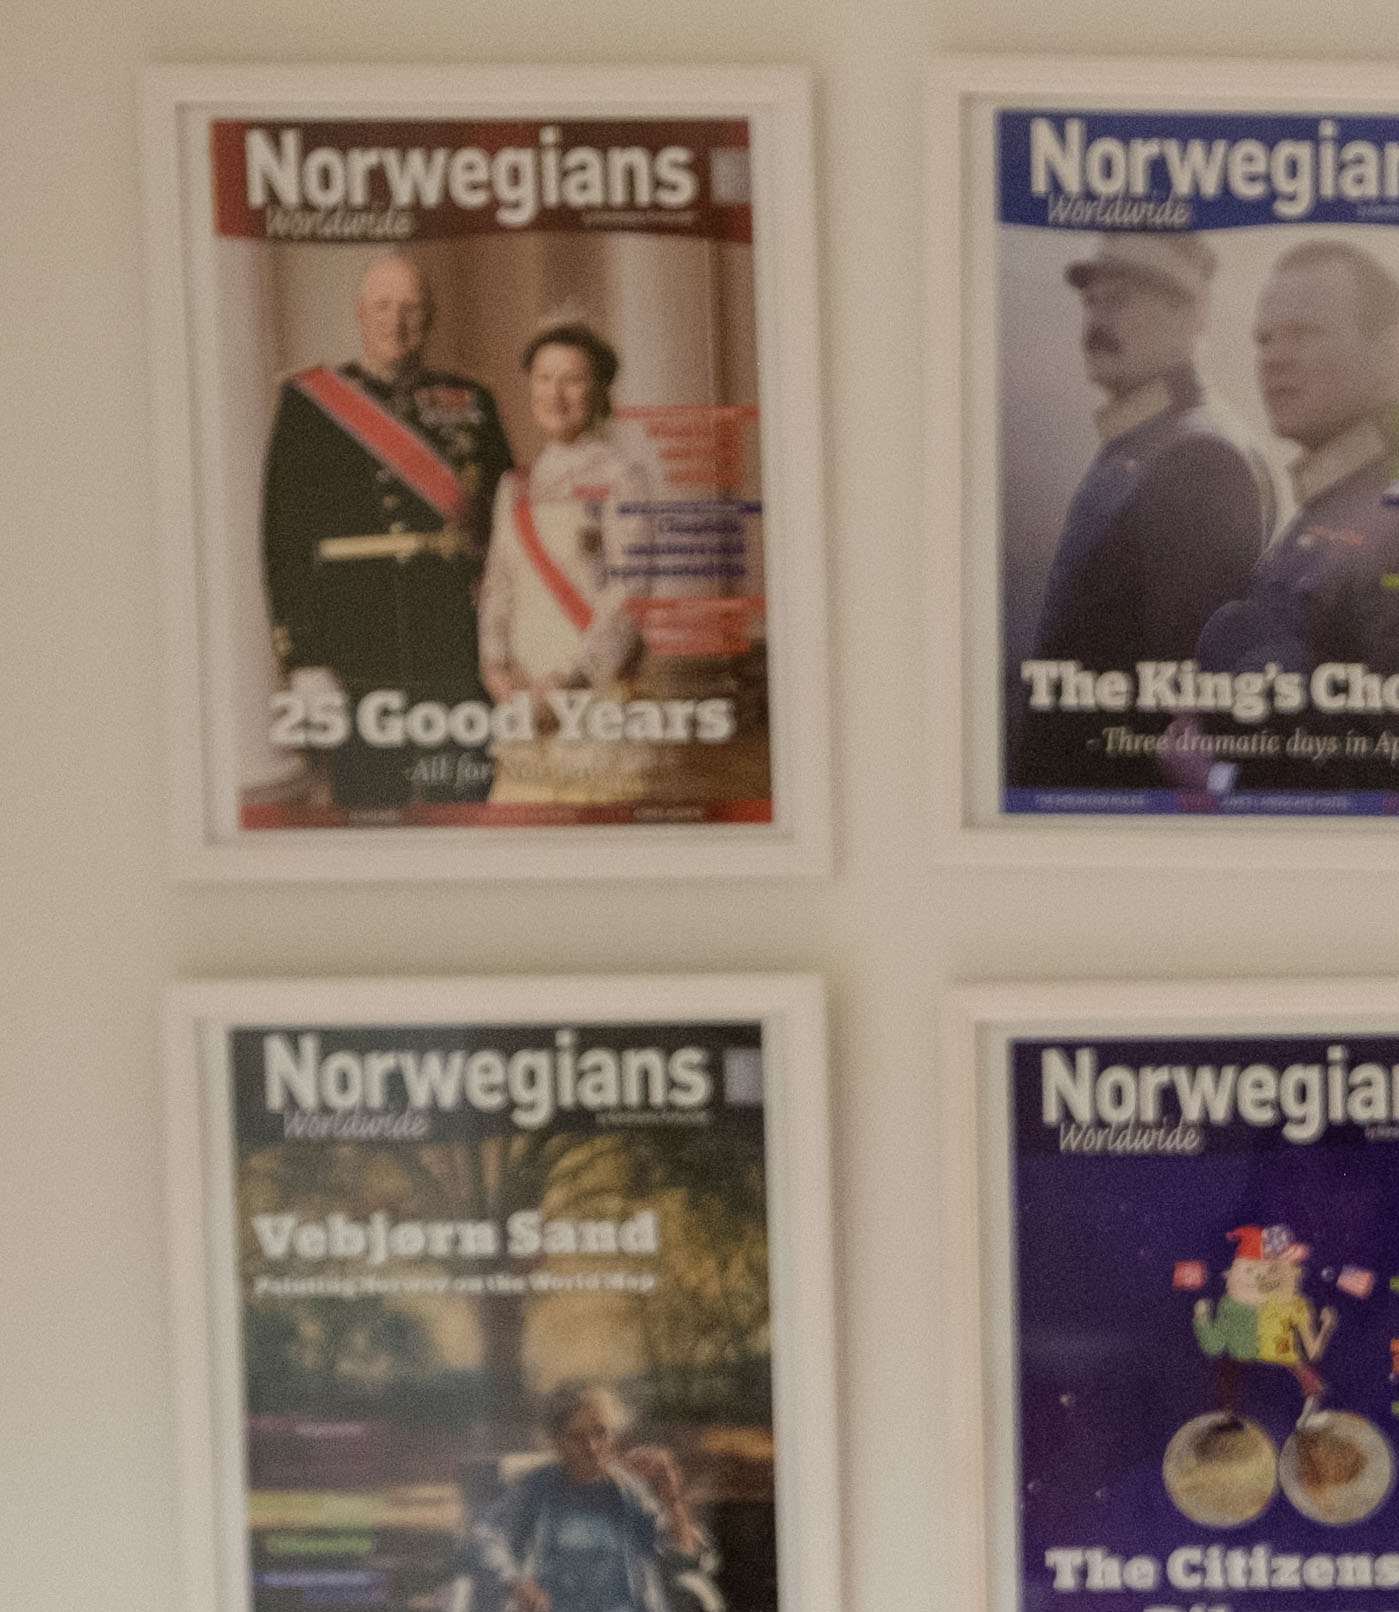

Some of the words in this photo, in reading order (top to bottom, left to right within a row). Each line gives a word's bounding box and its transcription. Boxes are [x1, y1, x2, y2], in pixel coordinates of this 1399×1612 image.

[245, 126, 698, 226] Norwegians
[1048, 194, 1193, 228] Worldwide
[1021, 659, 1132, 713] The
[1136, 659, 1304, 722] King's
[269, 691, 349, 748] 25
[357, 689, 533, 748] Good
[554, 691, 736, 744] Years
[1102, 726, 1171, 752] Three
[1175, 727, 1280, 754] dramatic
[1286, 727, 1338, 760] days
[1345, 730, 1367, 754] in
[264, 1030, 713, 1130] Norwegians
[282, 1107, 430, 1140] Worldwide
[1059, 1117, 1201, 1153] Worldwide
[506, 1209, 661, 1258] Sand
[486, 1275, 525, 1294] the
[528, 1273, 600, 1293] World
[1045, 1547, 1156, 1591] The
